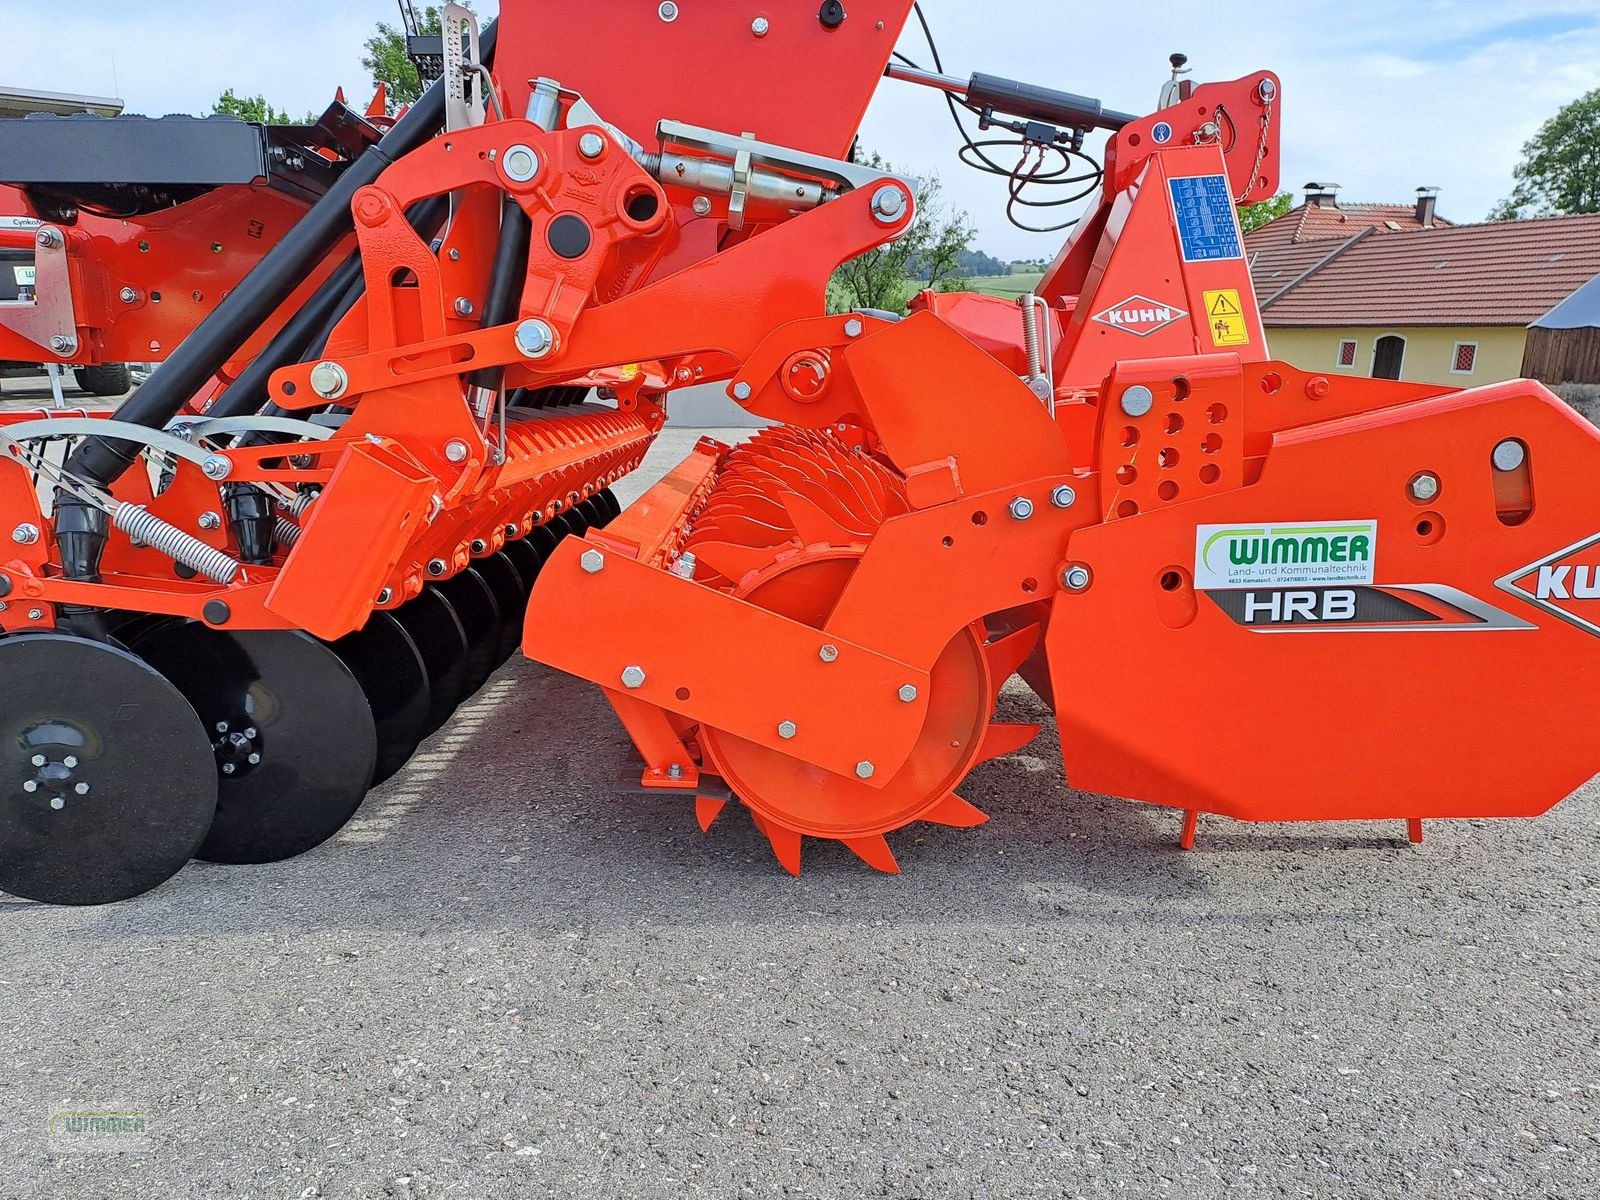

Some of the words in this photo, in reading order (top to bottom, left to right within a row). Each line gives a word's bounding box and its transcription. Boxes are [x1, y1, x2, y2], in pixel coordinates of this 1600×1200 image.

[1108, 308, 1171, 324] KUHN
[1229, 535, 1369, 565] WIMMER
[1228, 567, 1255, 576] Land-
[1258, 567, 1277, 575] und
[1280, 564, 1368, 575] Kommunaltechnik
[1244, 590, 1356, 622] HRB
